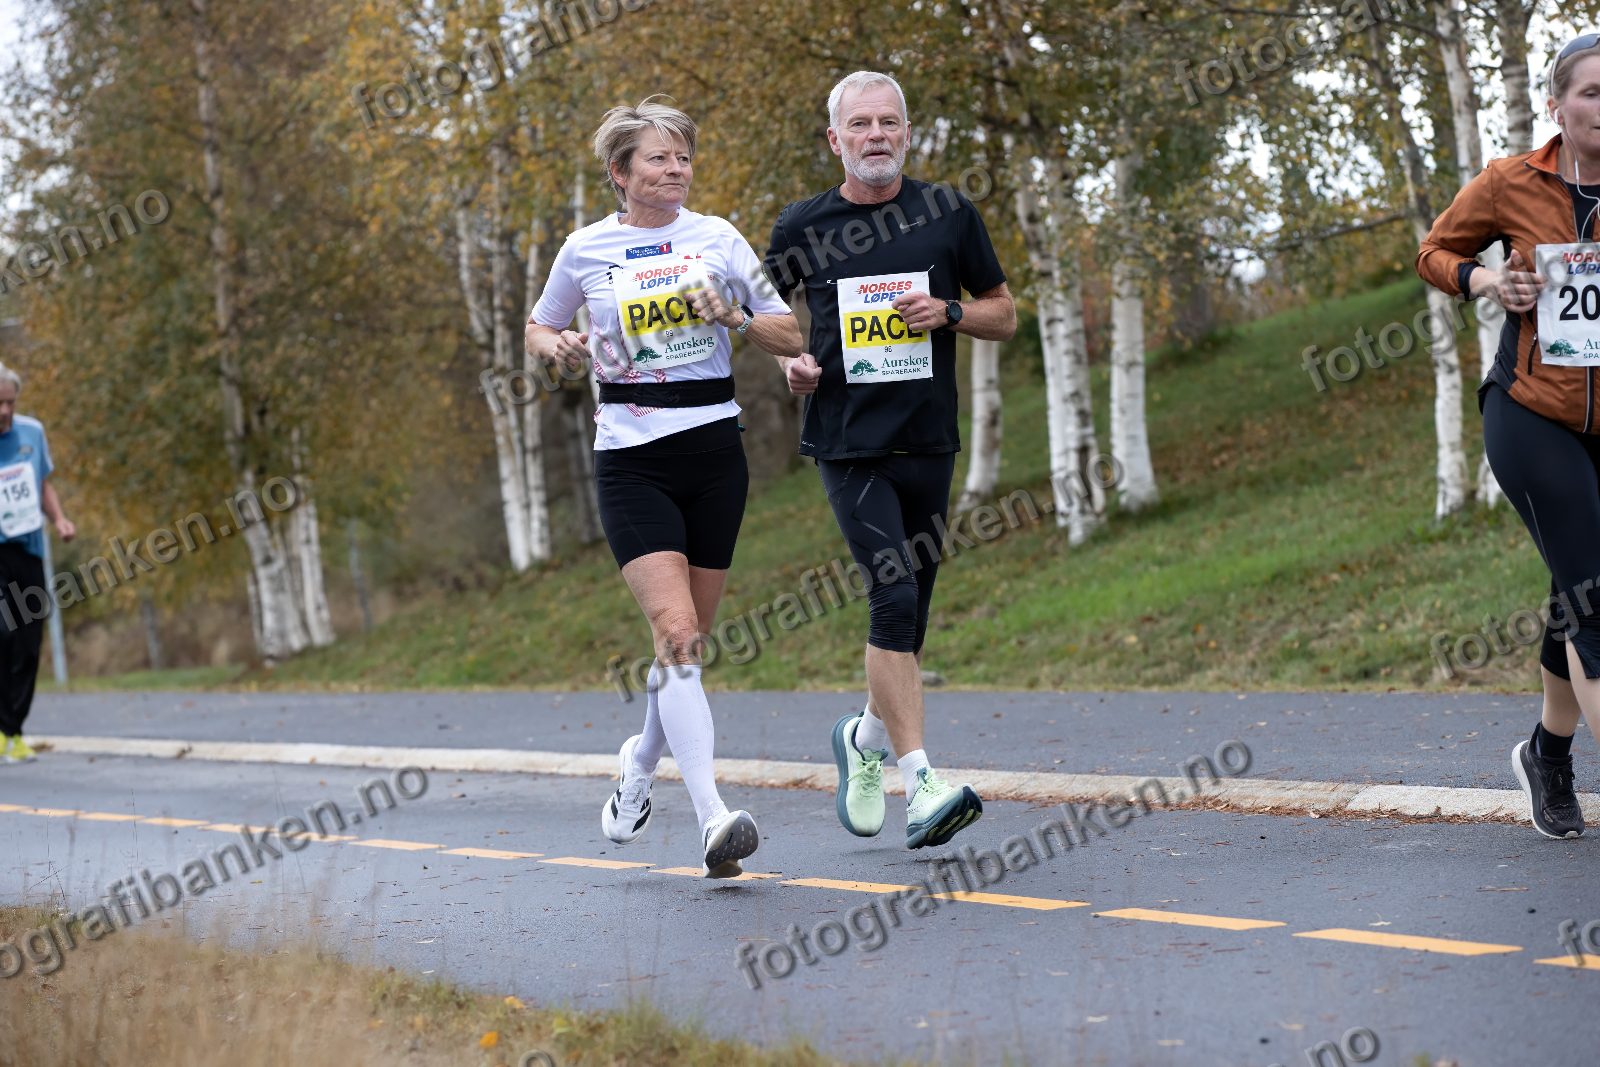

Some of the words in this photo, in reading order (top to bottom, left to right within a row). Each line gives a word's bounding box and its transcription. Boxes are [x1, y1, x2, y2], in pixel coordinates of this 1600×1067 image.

[634, 264, 688, 281] NORGES
[640, 274, 681, 291] LØPET
[858, 280, 913, 294] NORGES
[1558, 284, 1600, 321] 20
[664, 336, 715, 354] Aurskog
[665, 348, 706, 361] SPAREBANK
[881, 355, 929, 368] Aurskog
[881, 367, 921, 376] SPAREBANK
[3, 481, 30, 503] 156
